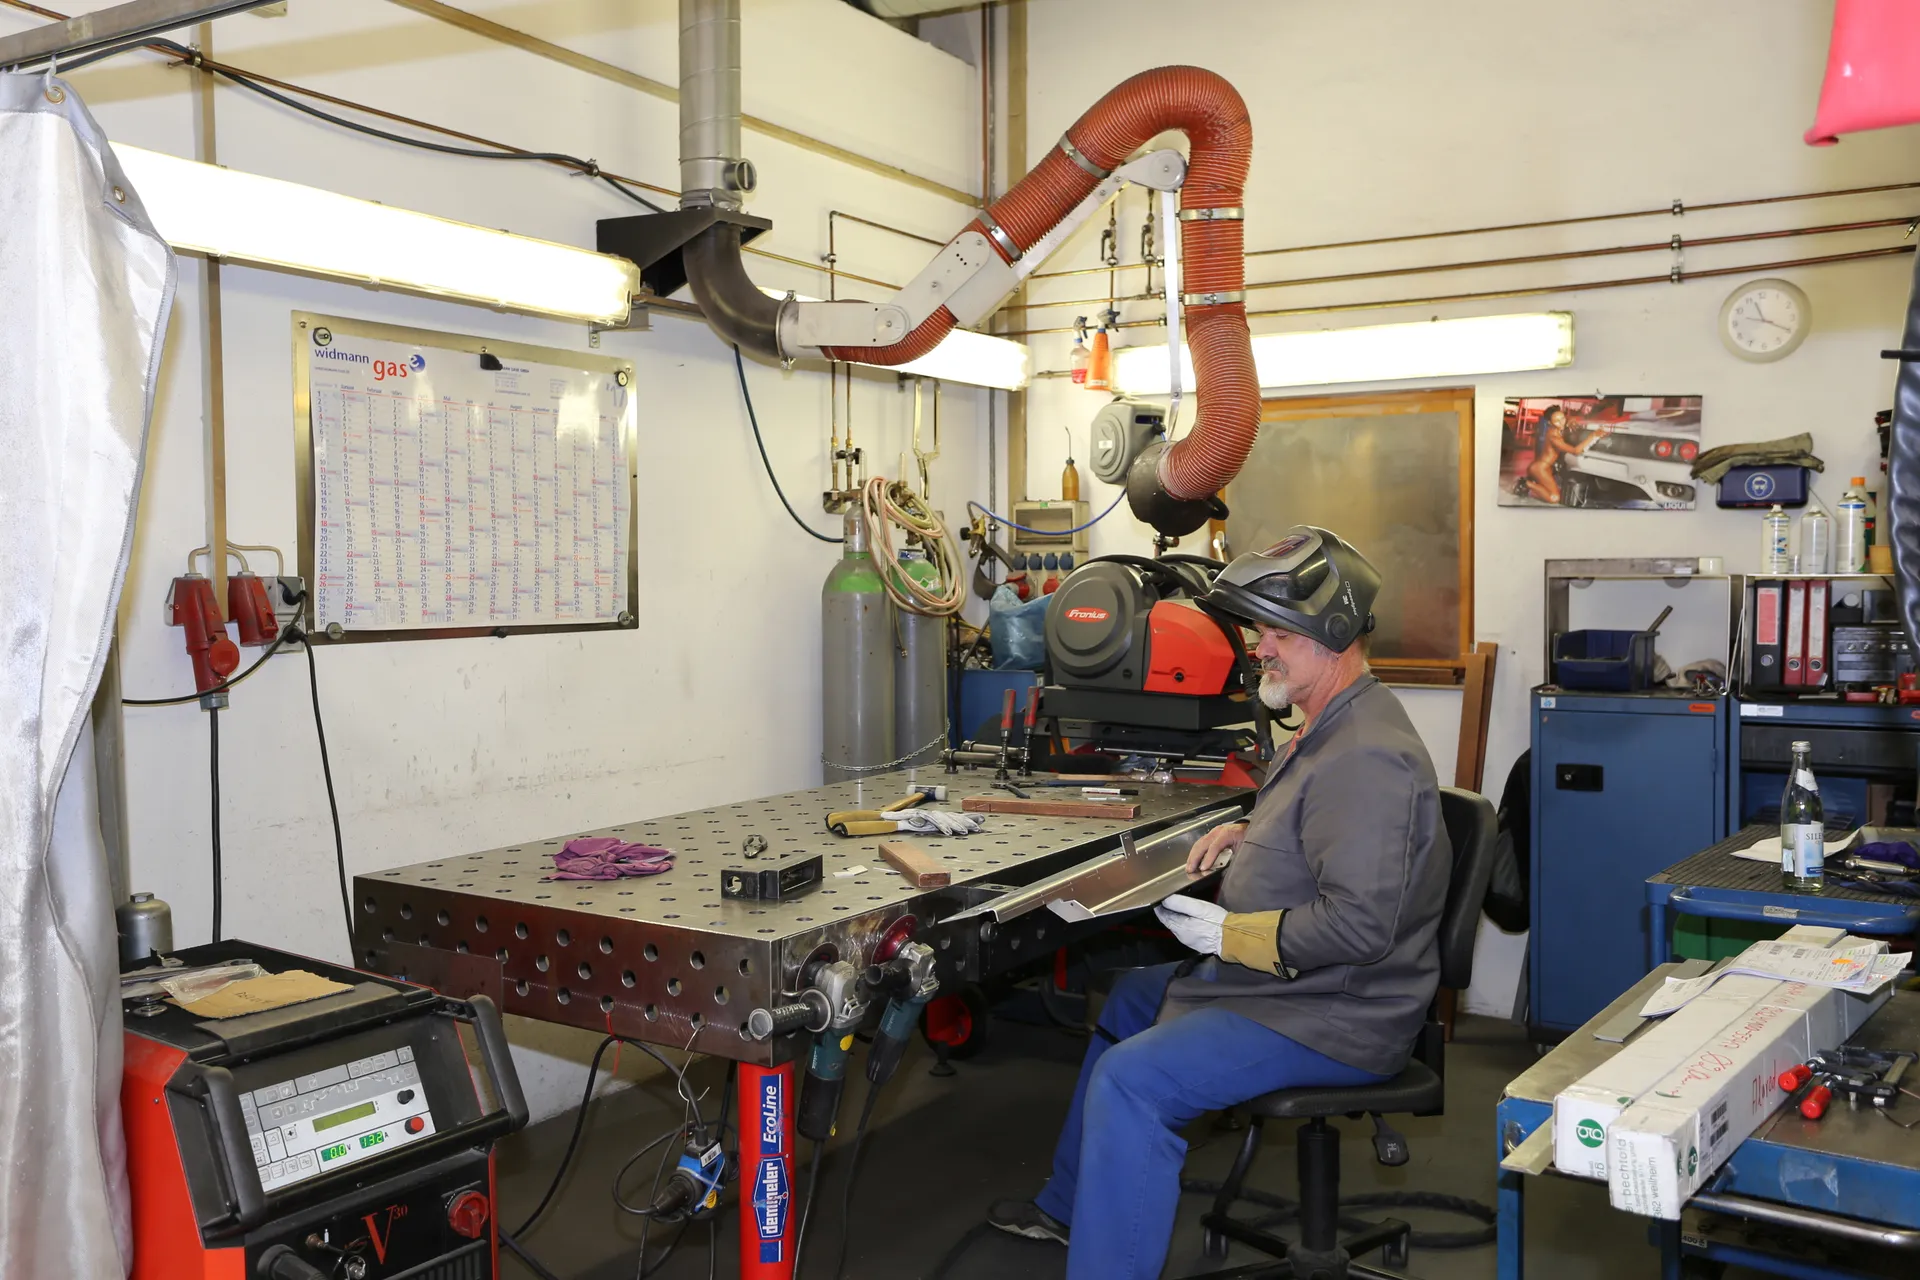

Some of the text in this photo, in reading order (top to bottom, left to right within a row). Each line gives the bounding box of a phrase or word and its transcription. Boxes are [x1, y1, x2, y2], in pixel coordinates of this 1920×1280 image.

[314, 348, 370, 364] widmann
[373, 360, 408, 380] gas
[1068, 609, 1107, 619] Fronius
[1805, 832, 1823, 841] SILE
[763, 1086, 777, 1144] EcoLine
[363, 1131, 382, 1147] 132
[1616, 1138, 1630, 1196] bechtold
[1648, 1157, 1660, 1198] weilheim
[763, 1162, 778, 1235] demmeler
